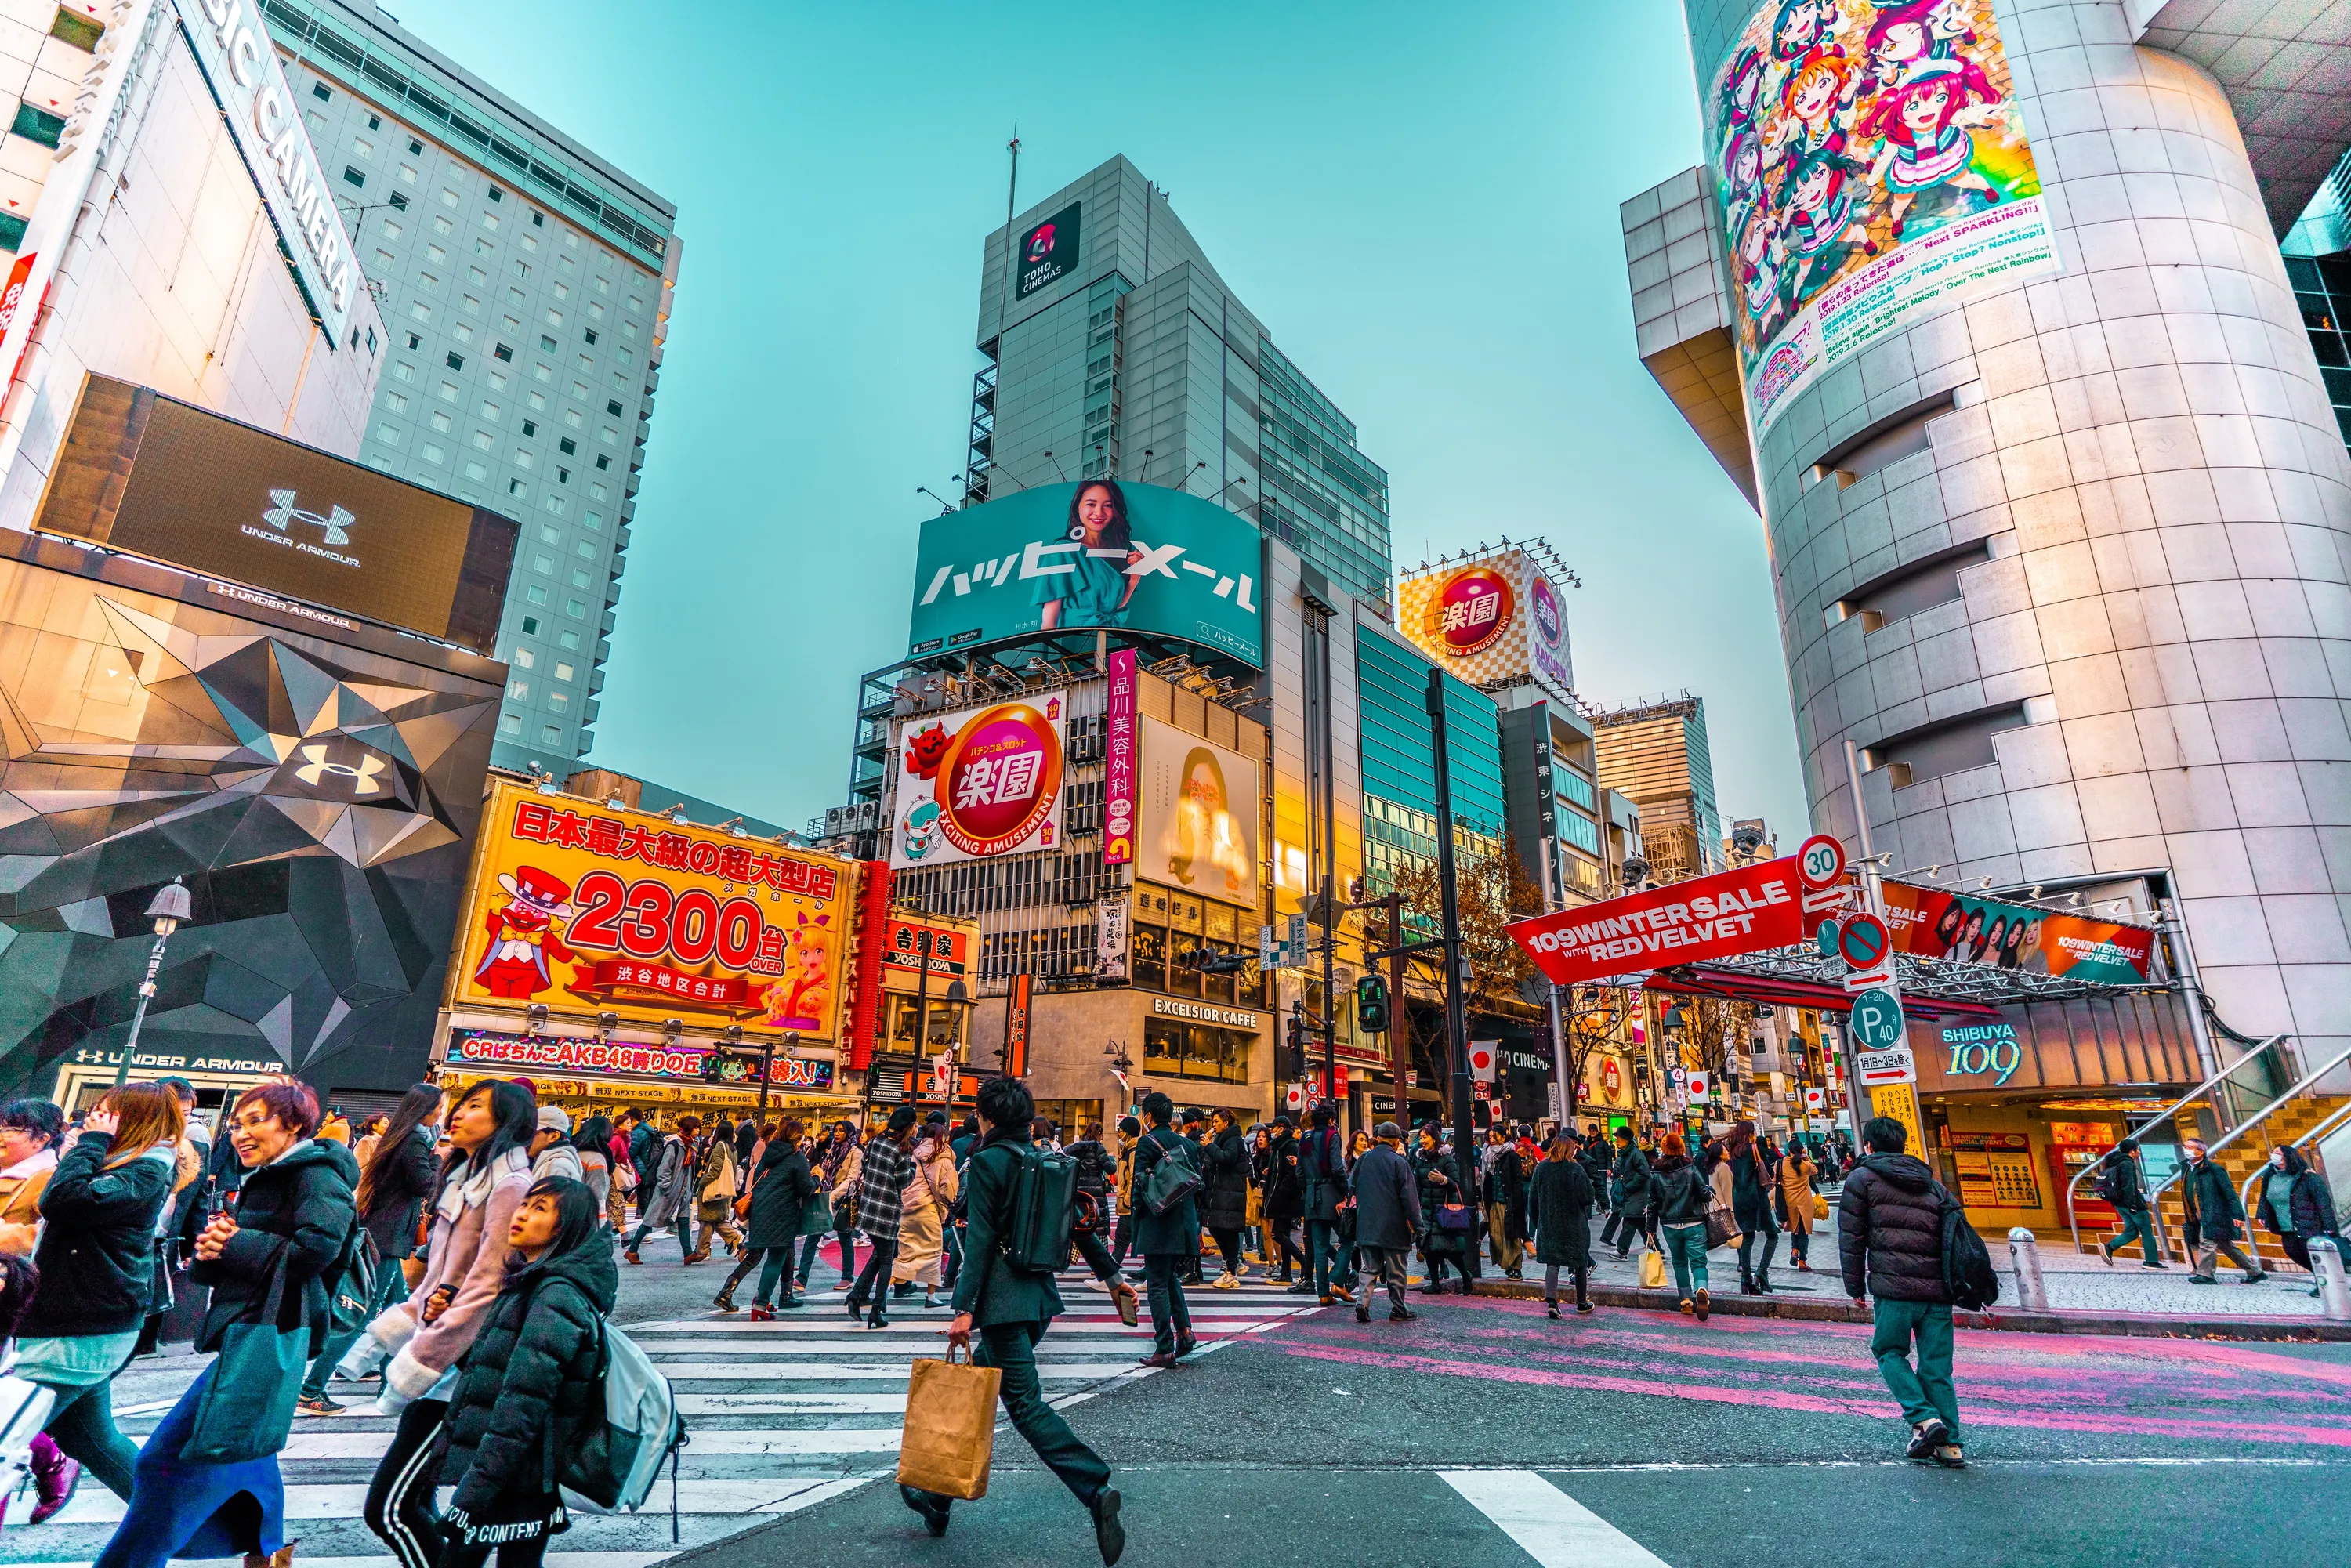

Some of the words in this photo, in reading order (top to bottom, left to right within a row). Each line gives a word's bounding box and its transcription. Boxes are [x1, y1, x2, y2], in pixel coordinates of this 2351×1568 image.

[254, 85, 349, 313] CAMERA
[1952, 246, 1985, 263] Stop?
[1023, 266, 1061, 293] CINEMAS
[1024, 261, 1051, 284] TOHO
[1818, 295, 1852, 320] 2019.1.23
[1853, 271, 1889, 297] Release!
[1852, 324, 1870, 339] again
[1875, 302, 1909, 324] Brightest
[1911, 288, 1940, 306] Melody
[1946, 279, 1966, 290] Over
[1969, 271, 1985, 281] The
[1987, 264, 2008, 275] Next
[1823, 317, 1857, 342] 2019.1.30
[1859, 293, 1896, 317] Release!
[1827, 340, 1858, 364] 2019.2.6
[1860, 317, 1896, 342] Release!
[241, 525, 294, 548] UNDER
[919, 526, 1255, 614] ハッピーメール
[237, 590, 286, 612] UNDER
[1440, 592, 1499, 634] 楽園
[1538, 598, 1556, 632] 楽園
[1214, 630, 1256, 657] ハッピーメール
[1429, 634, 1462, 656] EXCITING
[1465, 614, 1511, 655] AMUSEMENT
[1535, 642, 1567, 681] RAKUEN
[1048, 704, 1059, 712] 40
[970, 738, 1027, 757] パチンコ&スロット
[1111, 676, 1130, 797] 品川美容外科
[952, 750, 1043, 810] 楽園
[940, 809, 980, 853] EXCITING
[984, 792, 1054, 855] AMUSEMENT
[1042, 827, 1052, 837] 30
[511, 799, 838, 901] 日本最大級の超大型店
[1807, 847, 1835, 876] 30
[724, 882, 824, 910] メガホール
[1851, 914, 1867, 924] 20-7
[894, 954, 951, 972] YOSHOYA
[1563, 946, 1589, 958] WITH
[750, 958, 784, 975] OVER
[1824, 966, 1846, 977] ここから
[617, 965, 727, 1000] 渋谷地区合計
[1862, 992, 1884, 1004] 7-20
[1016, 1008, 1025, 1042] 吉野家
[1154, 999, 1219, 1022] EXCELSIOR
[1222, 1009, 1257, 1029] CAFFÉ
[1862, 1007, 1882, 1043] P
[1892, 1014, 1896, 1025] 分
[1879, 1024, 1893, 1041] 40
[1941, 1023, 2016, 1042] SHIBUYA
[108, 1053, 185, 1069] UNDER
[190, 1057, 283, 1073] ARMOUR
[945, 1051, 951, 1062] 3
[1513, 1052, 1550, 1070] CINEM
[1945, 1038, 2021, 1087] 109
[1606, 1071, 1618, 1088] 楽園
[1675, 1070, 1682, 1080] 4
[595, 1087, 612, 1095] 無双
[690, 1093, 706, 1102] 無双
[564, 1103, 584, 1111] STAGE
[643, 1107, 656, 1121] 双
[661, 1110, 683, 1119] NEXT
[1903, 1088, 1911, 1120] この通り
[702, 1108, 729, 1127] 無双
